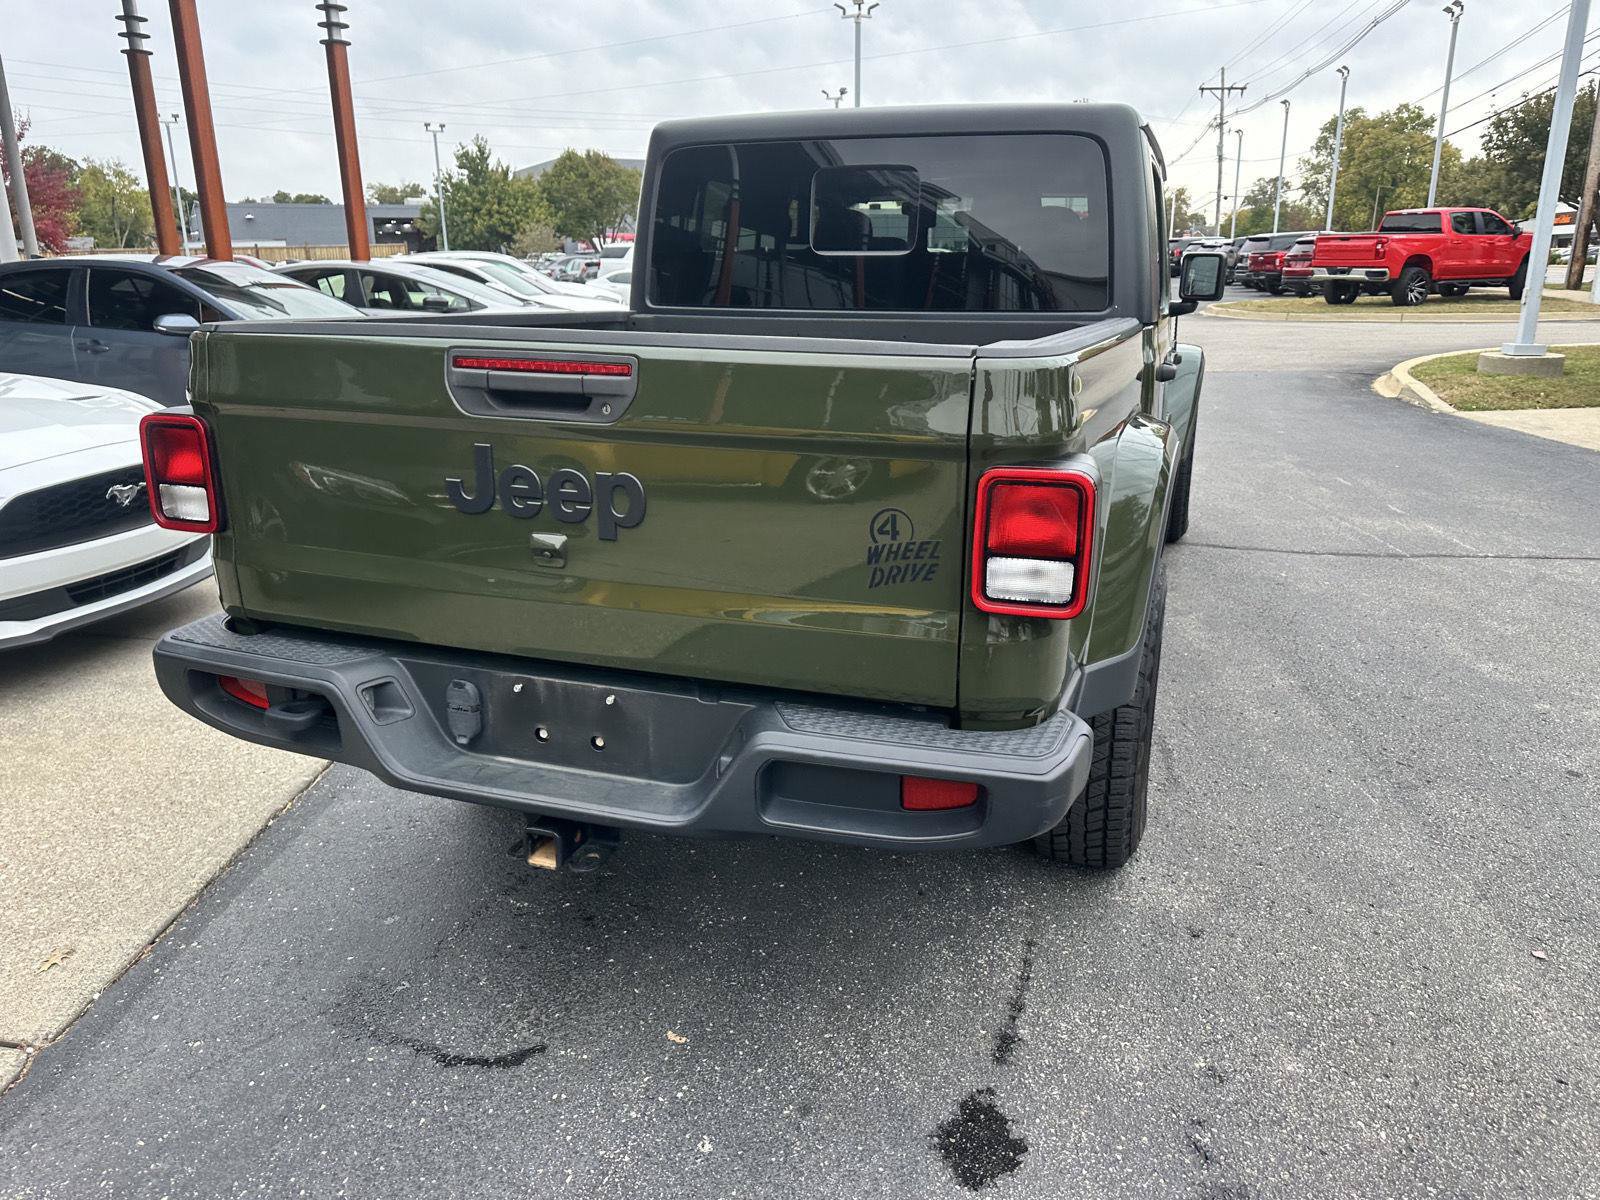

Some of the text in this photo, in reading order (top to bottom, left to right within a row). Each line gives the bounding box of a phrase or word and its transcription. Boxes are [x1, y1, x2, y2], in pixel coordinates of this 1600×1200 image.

[445, 443, 647, 541] Jeep
[877, 513, 900, 541] 4
[867, 541, 942, 566] WHEEL
[868, 563, 940, 589] DRIVE
